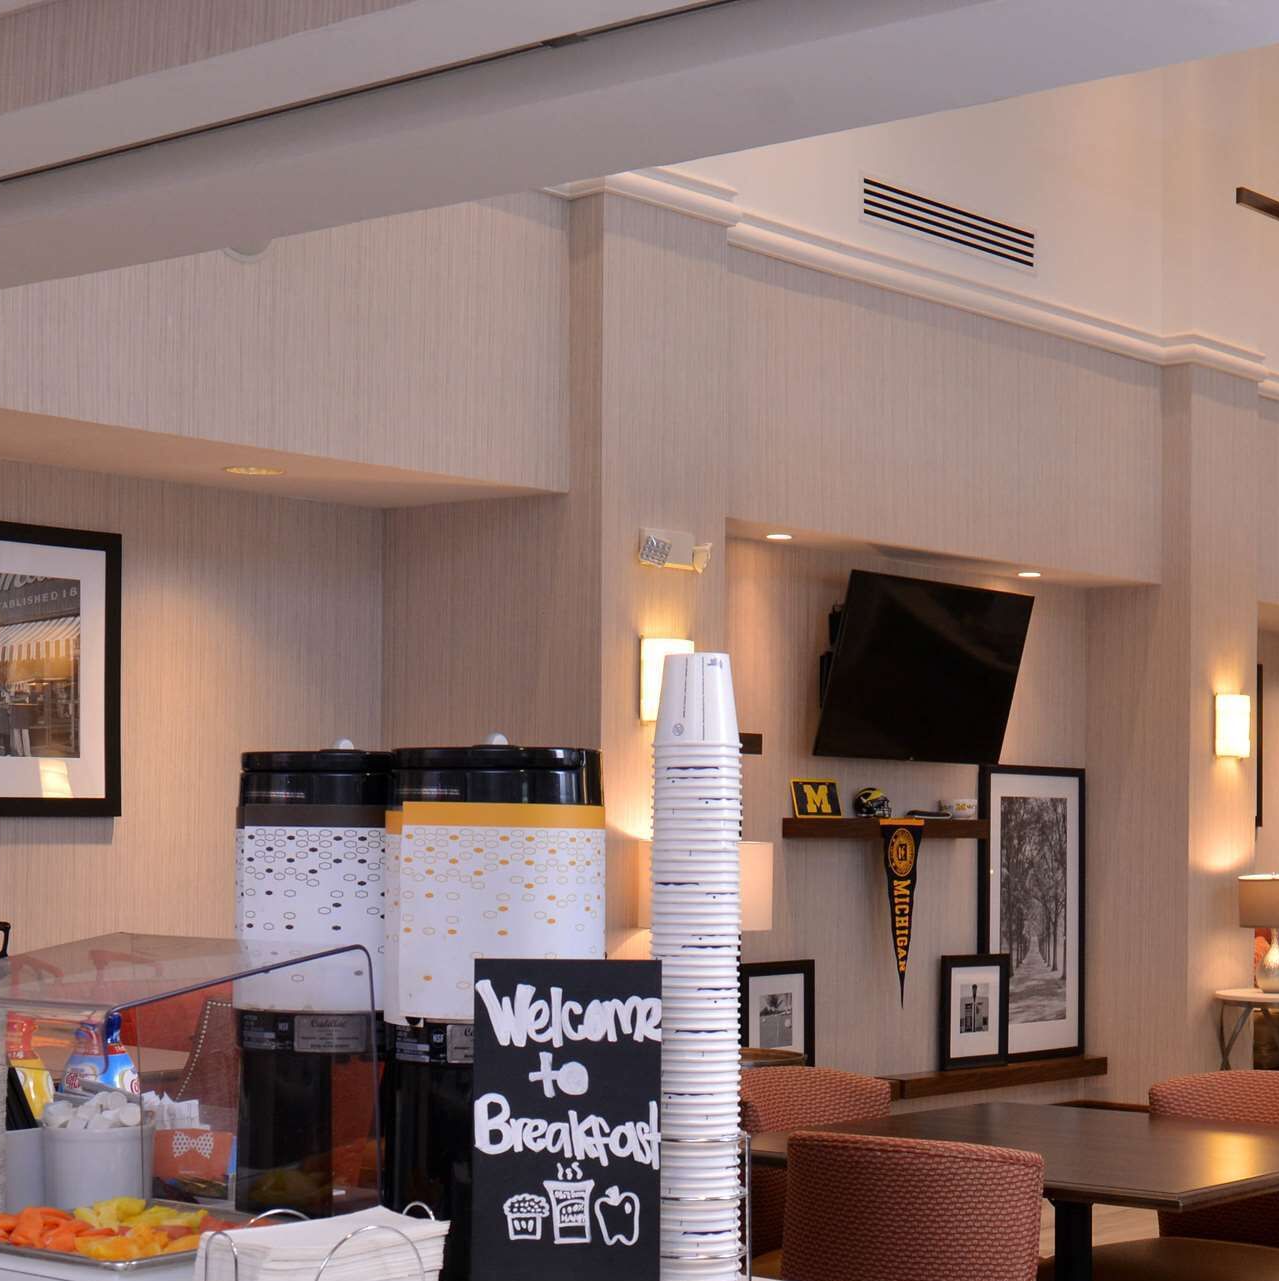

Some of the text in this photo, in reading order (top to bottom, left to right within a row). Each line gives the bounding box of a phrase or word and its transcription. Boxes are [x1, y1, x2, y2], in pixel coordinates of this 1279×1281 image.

[803, 783, 833, 814] M
[893, 879, 912, 972] MICHIGAN
[475, 978, 662, 1049] Welcome
[528, 1051, 590, 1099] to
[474, 1092, 661, 1170] Breakfast
